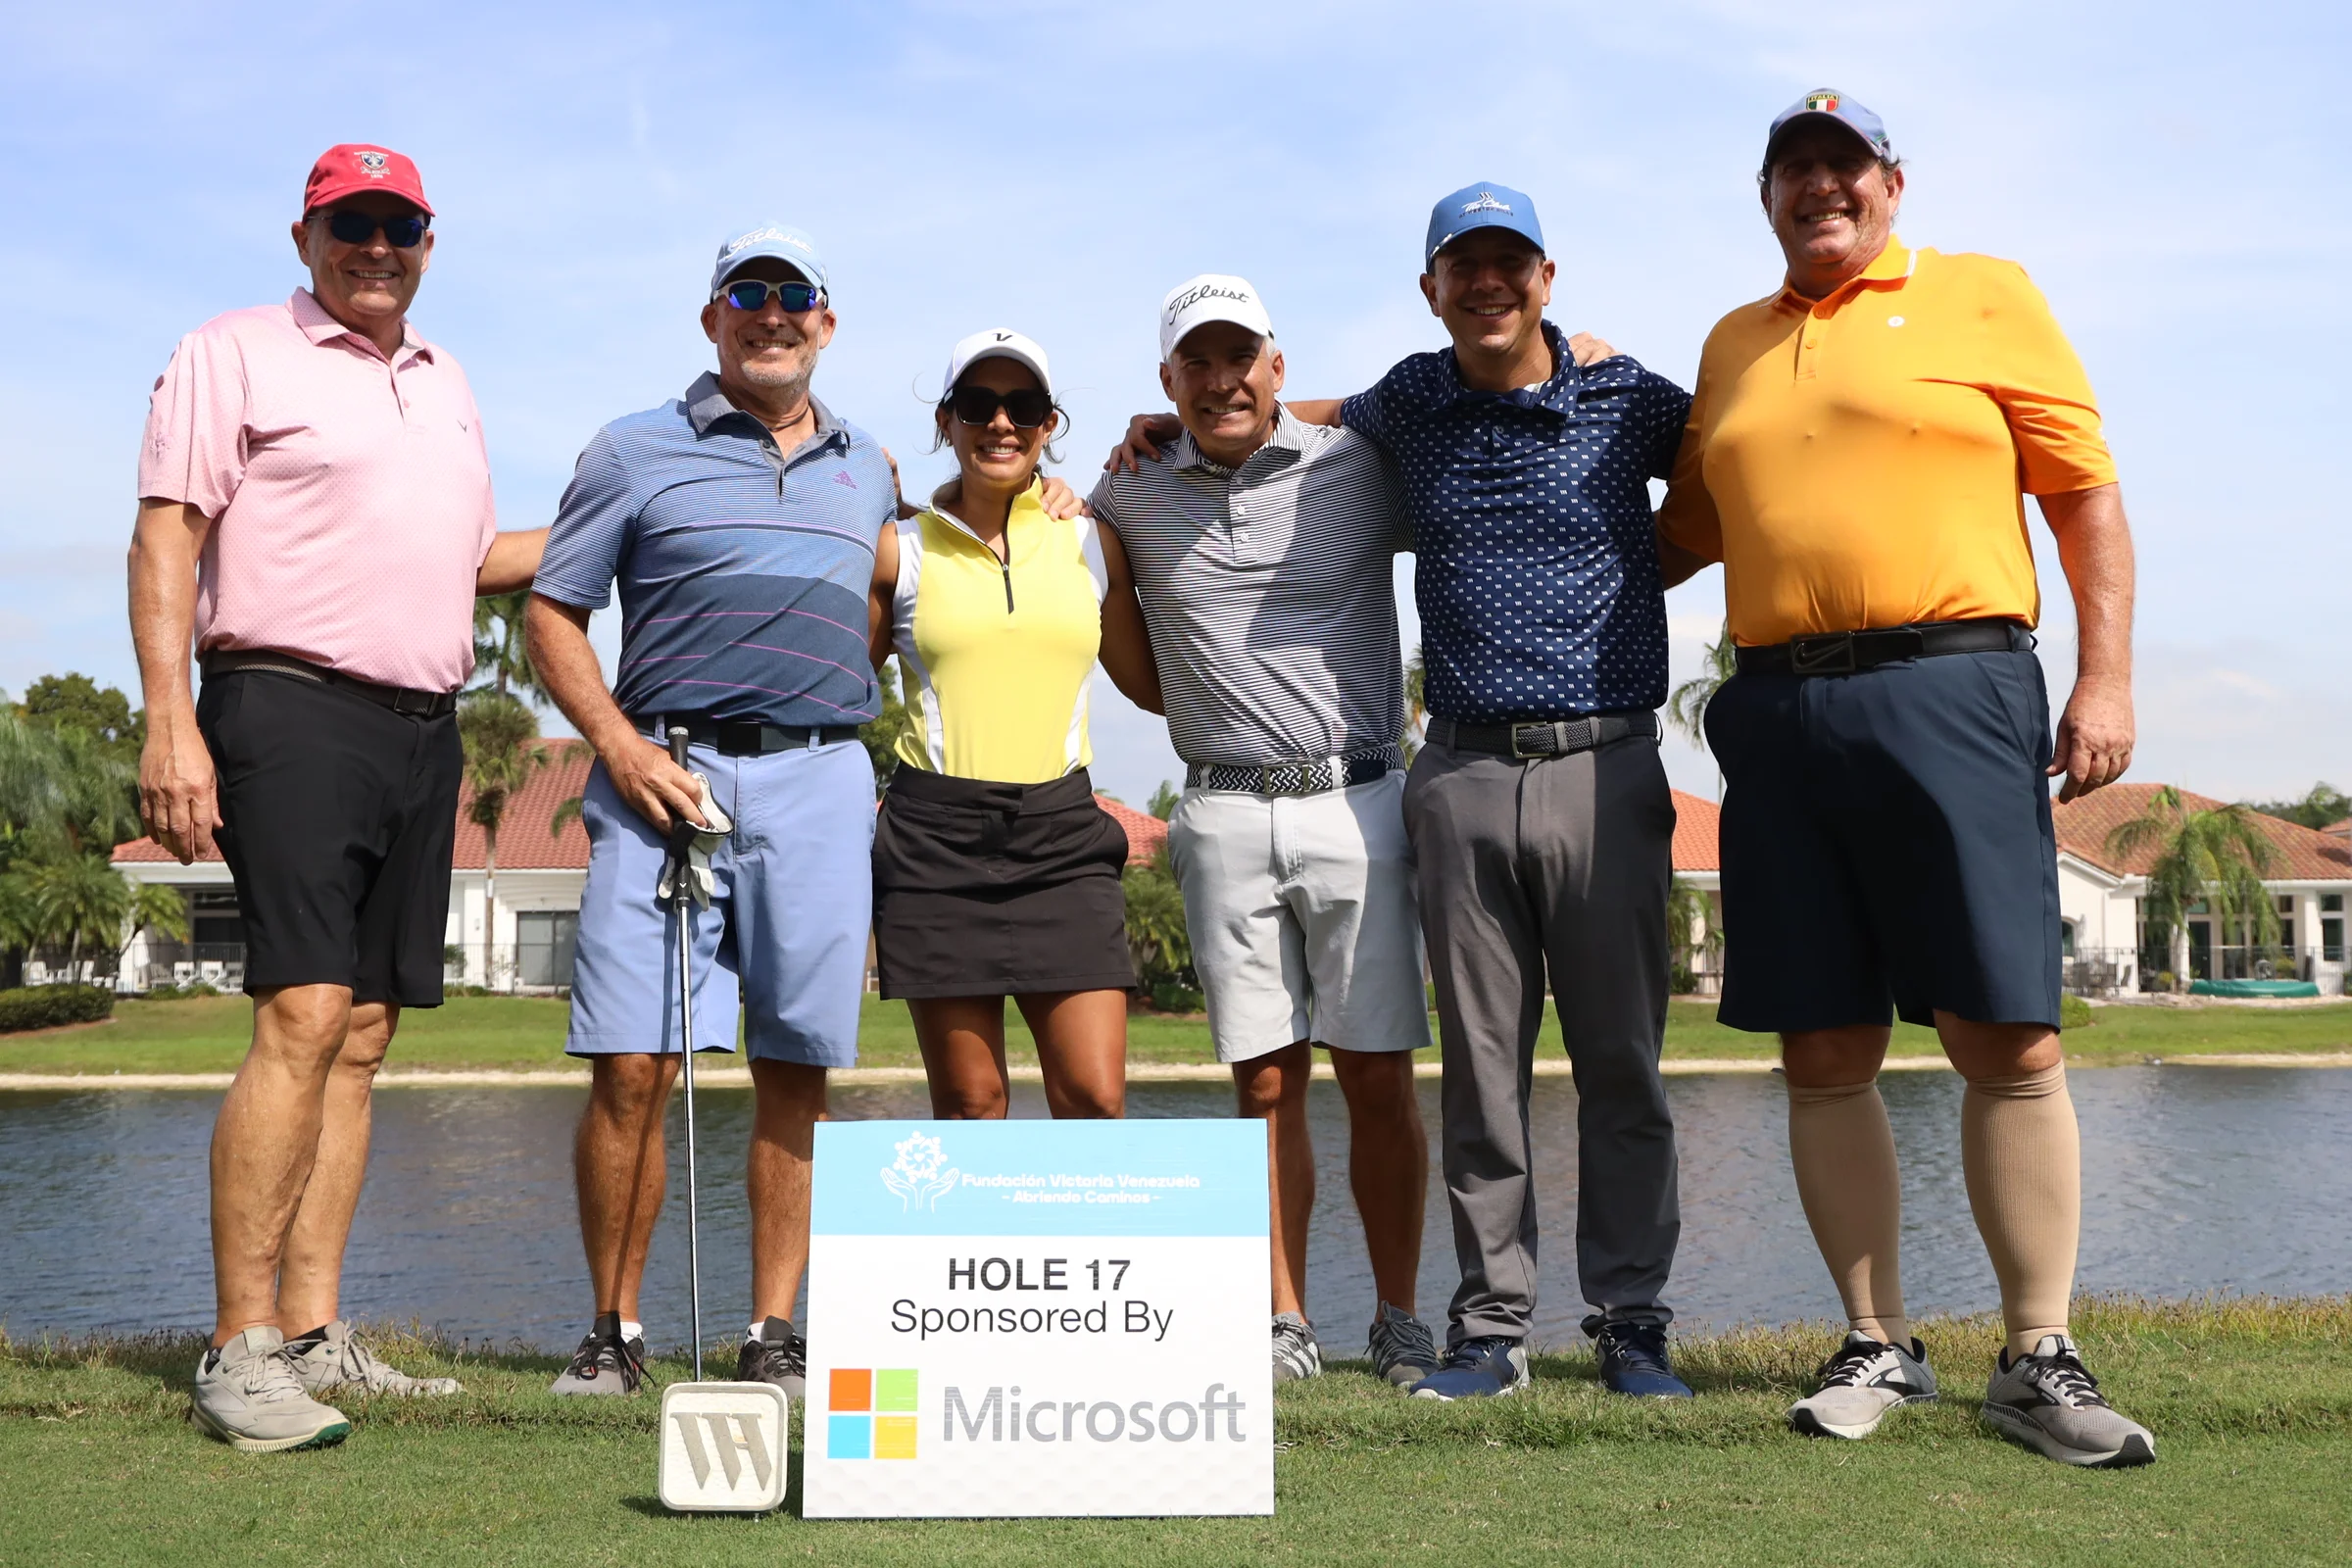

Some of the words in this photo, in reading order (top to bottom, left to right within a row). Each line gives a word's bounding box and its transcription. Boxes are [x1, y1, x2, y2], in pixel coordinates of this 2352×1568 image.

[1168, 284, 1250, 326] Titleist
[961, 1173, 1047, 1188] Fundación
[1049, 1173, 1114, 1188] Victoria
[1116, 1173, 1200, 1189] Venezuela
[1012, 1190, 1082, 1203] Abriendo
[1084, 1190, 1152, 1203] Caminos
[949, 1256, 1068, 1291] HOLE
[1085, 1258, 1131, 1291] 17
[891, 1298, 1106, 1342] Sponsored
[1124, 1299, 1174, 1342] By
[943, 1382, 1247, 1443] Microsoft
